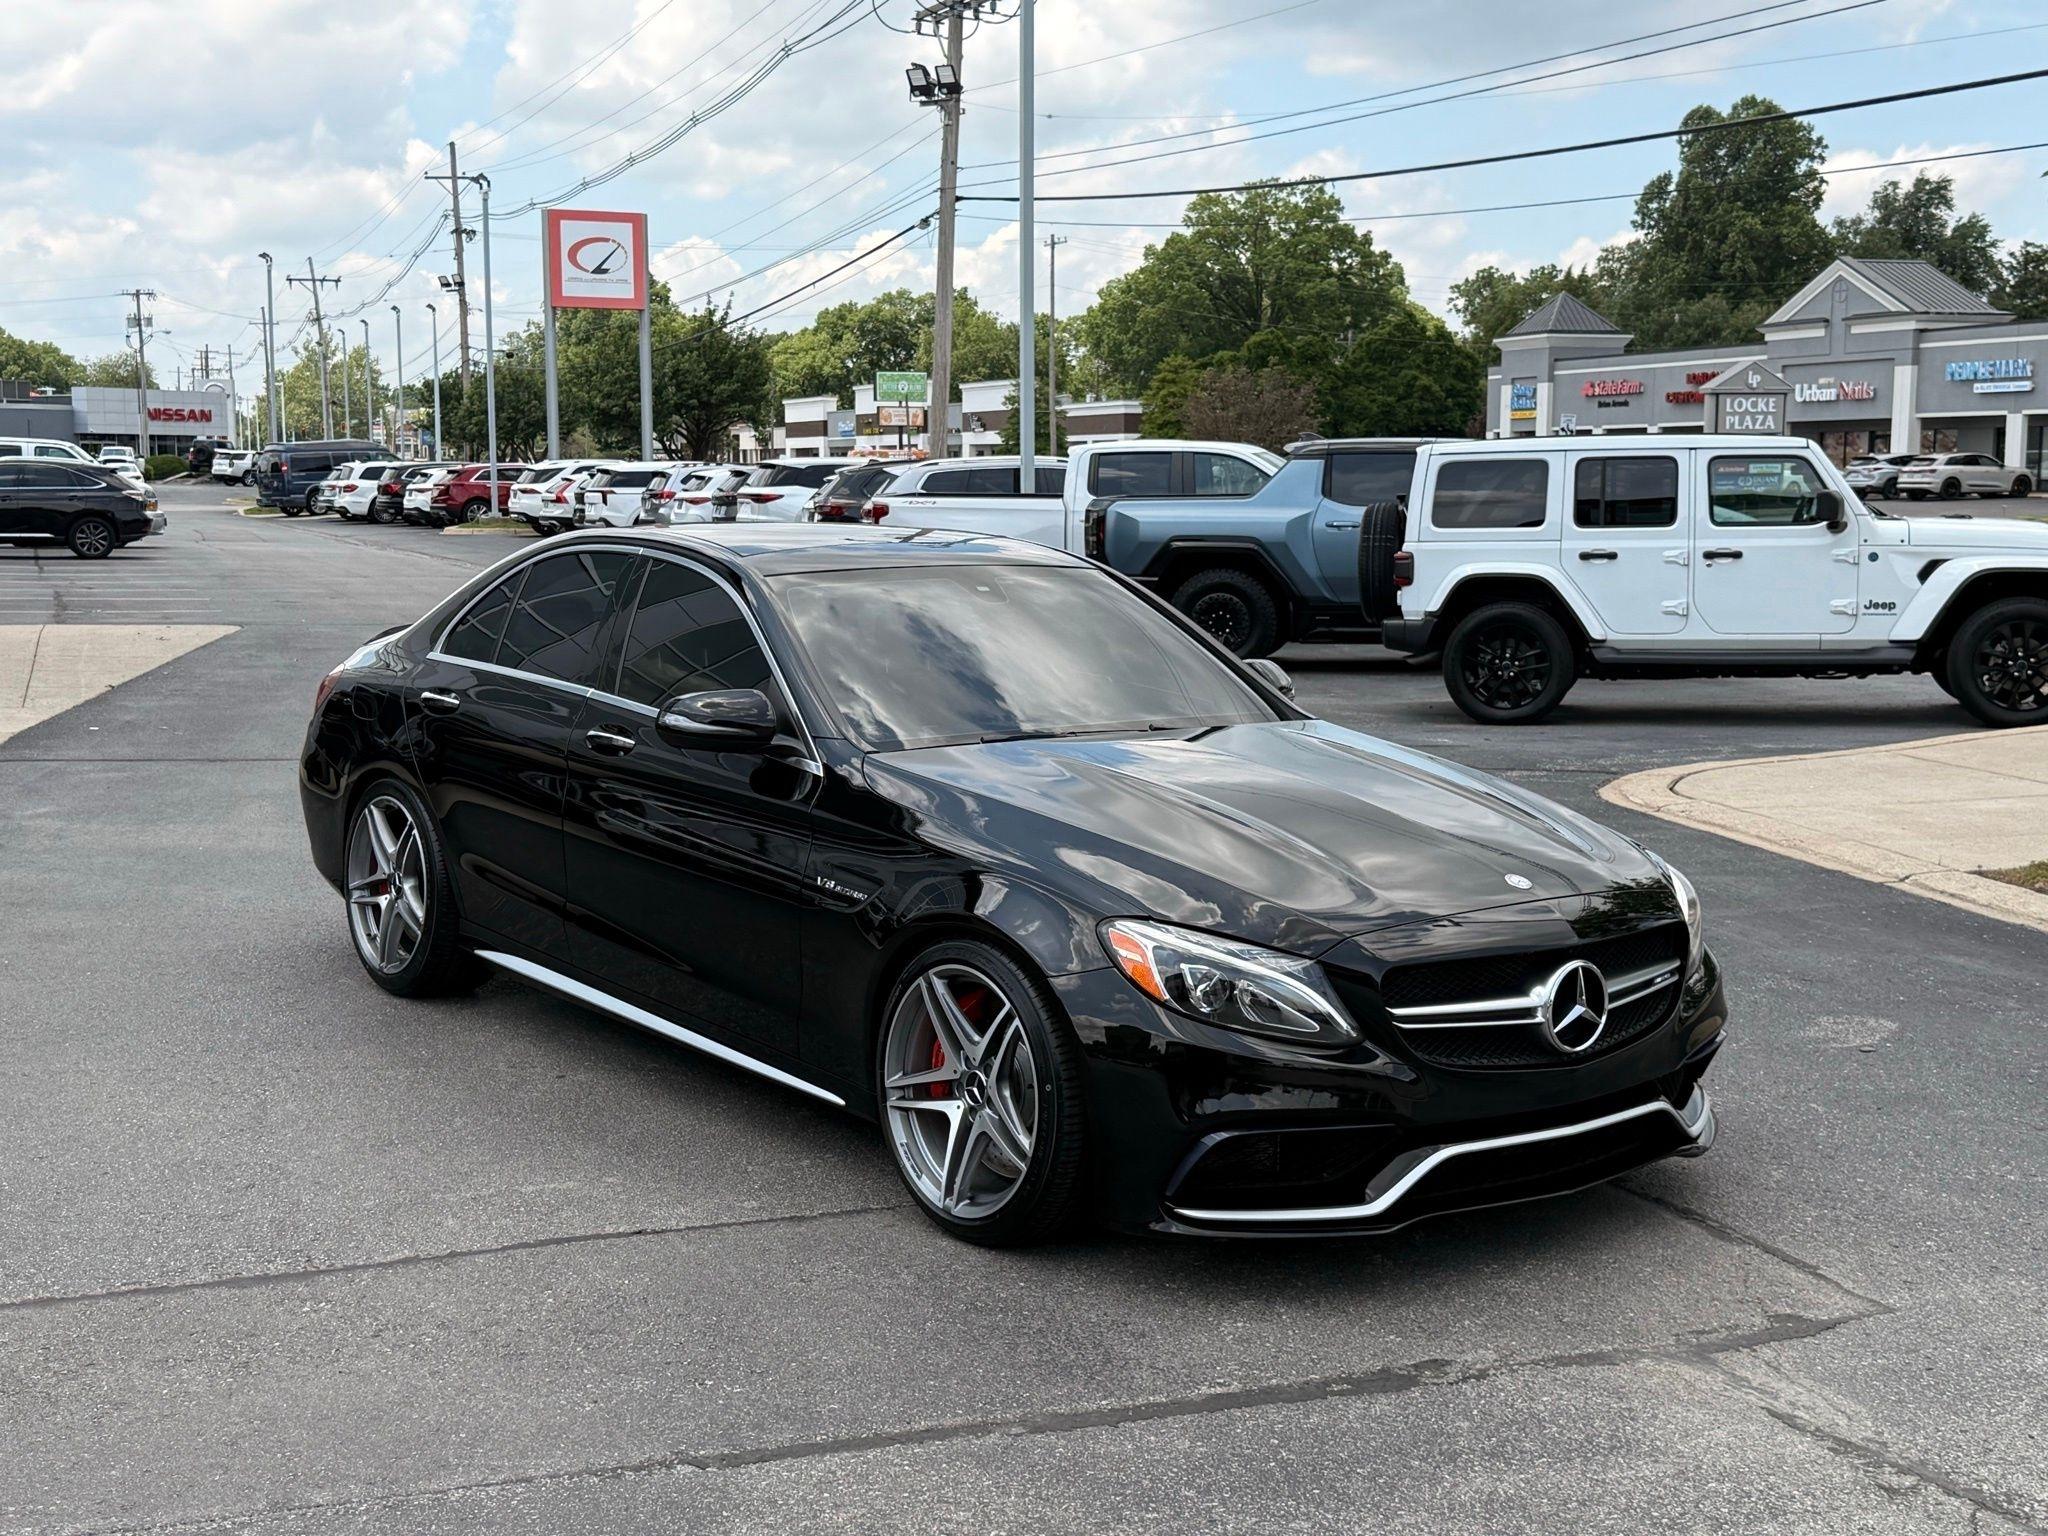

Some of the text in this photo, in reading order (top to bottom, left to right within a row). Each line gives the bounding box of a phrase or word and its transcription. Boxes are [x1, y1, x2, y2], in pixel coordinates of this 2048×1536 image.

[1795, 381, 1874, 402] Urban Nails
[1725, 398, 1777, 412] LOCKE
[147, 407, 213, 423] NISSAN
[1725, 415, 1776, 430] PLAZA
[1863, 599, 1897, 612] Jeep
[817, 876, 835, 888] V8
